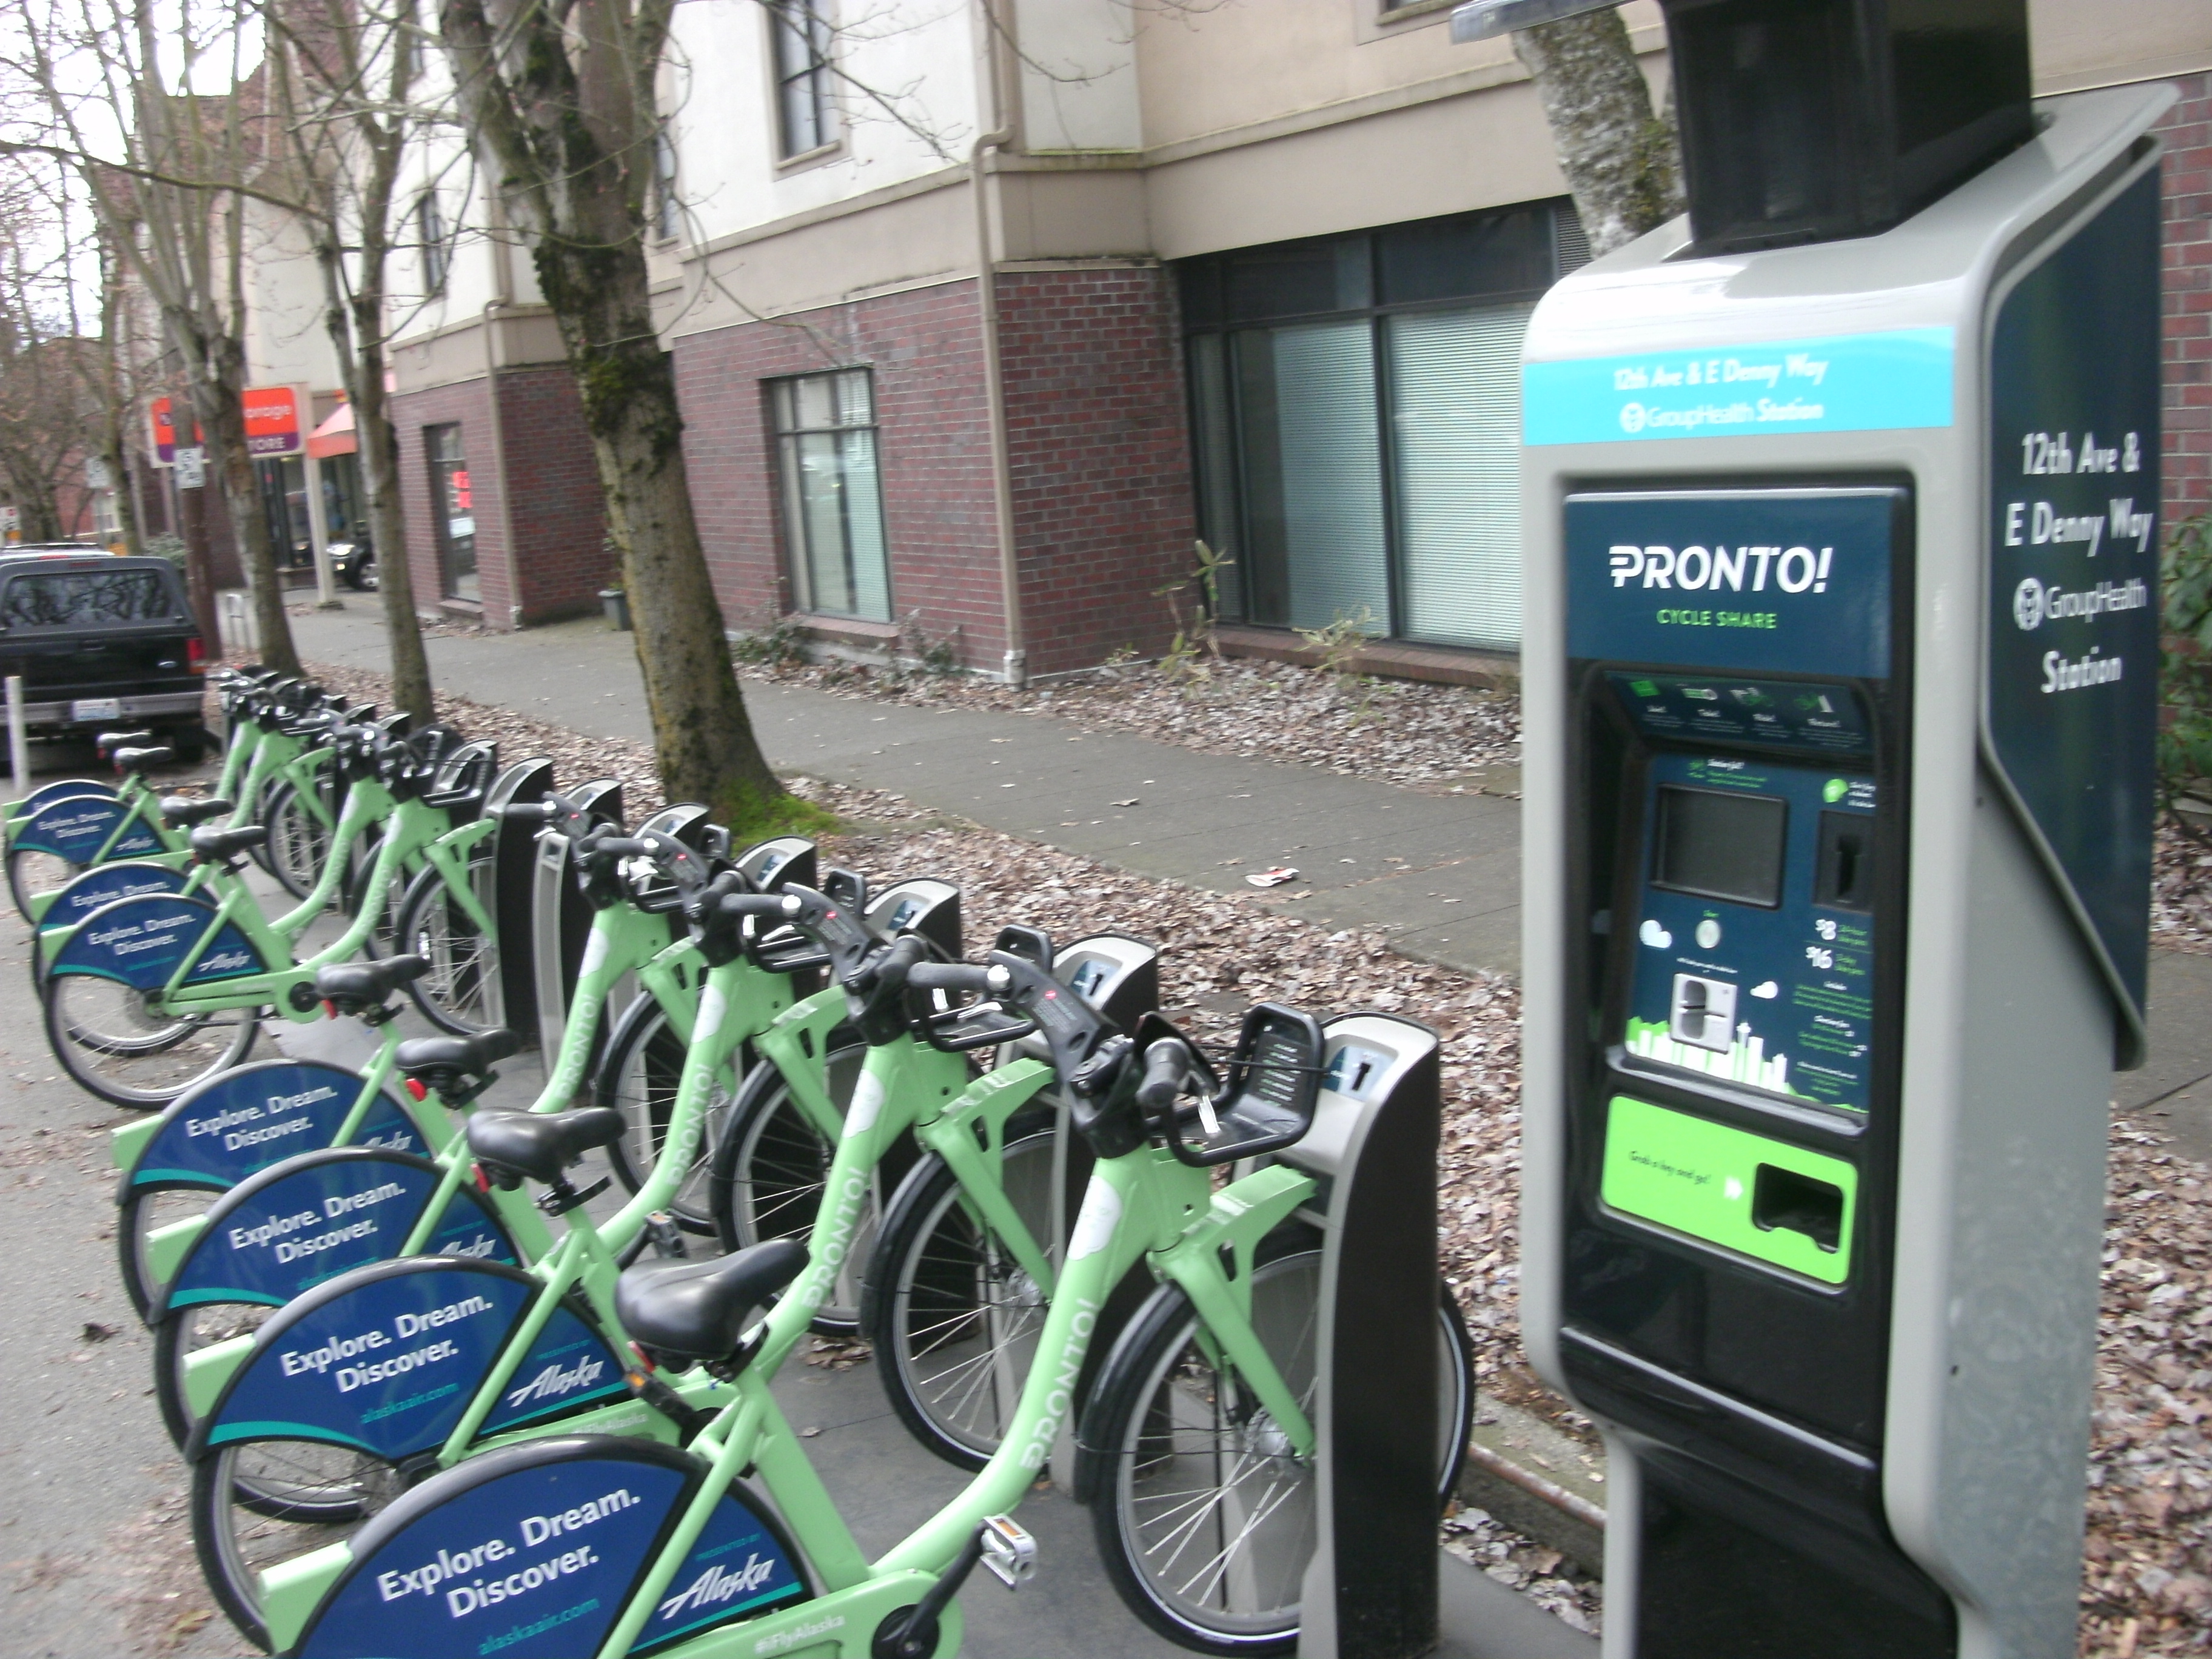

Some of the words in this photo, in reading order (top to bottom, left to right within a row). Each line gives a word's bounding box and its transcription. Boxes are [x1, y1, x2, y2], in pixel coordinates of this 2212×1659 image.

[1685, 361, 1703, 385] &
[1704, 360, 1720, 384] E
[243, 406, 292, 420] orage
[247, 437, 285, 452] TORE
[2022, 432, 2073, 474] 12th
[2075, 432, 2118, 473] Ave
[2122, 432, 2140, 472] &
[2005, 503, 2025, 546] E
[2030, 501, 2105, 557] Denny
[2109, 498, 2154, 553] Way
[1609, 546, 1833, 594] PRONTO!
[1657, 609, 1711, 626] CYCLE
[1716, 611, 1777, 629] SHARE
[2040, 646, 2122, 694] Station
[88, 926, 144, 945] Explore.
[144, 914, 196, 932] Dream.
[113, 934, 178, 956] Discover.
[185, 1105, 266, 1138] Explore.
[267, 1087, 338, 1115] Dream.
[223, 1115, 314, 1151] Discover.
[229, 1209, 323, 1250] Explore.
[324, 1182, 407, 1219] Dream.
[801, 1166, 868, 1307] PRONTO!
[274, 1218, 379, 1264] Discover.
[280, 1330, 393, 1377] Explore.
[395, 1295, 494, 1339] Dream.
[335, 1339, 460, 1393] Discover.
[1018, 1298, 1102, 1470] PRONTO!
[377, 1539, 516, 1603] Explore.
[520, 1489, 642, 1547] Dream.
[446, 1545, 599, 1618] Discover.
[658, 1552, 776, 1620] Alaska
